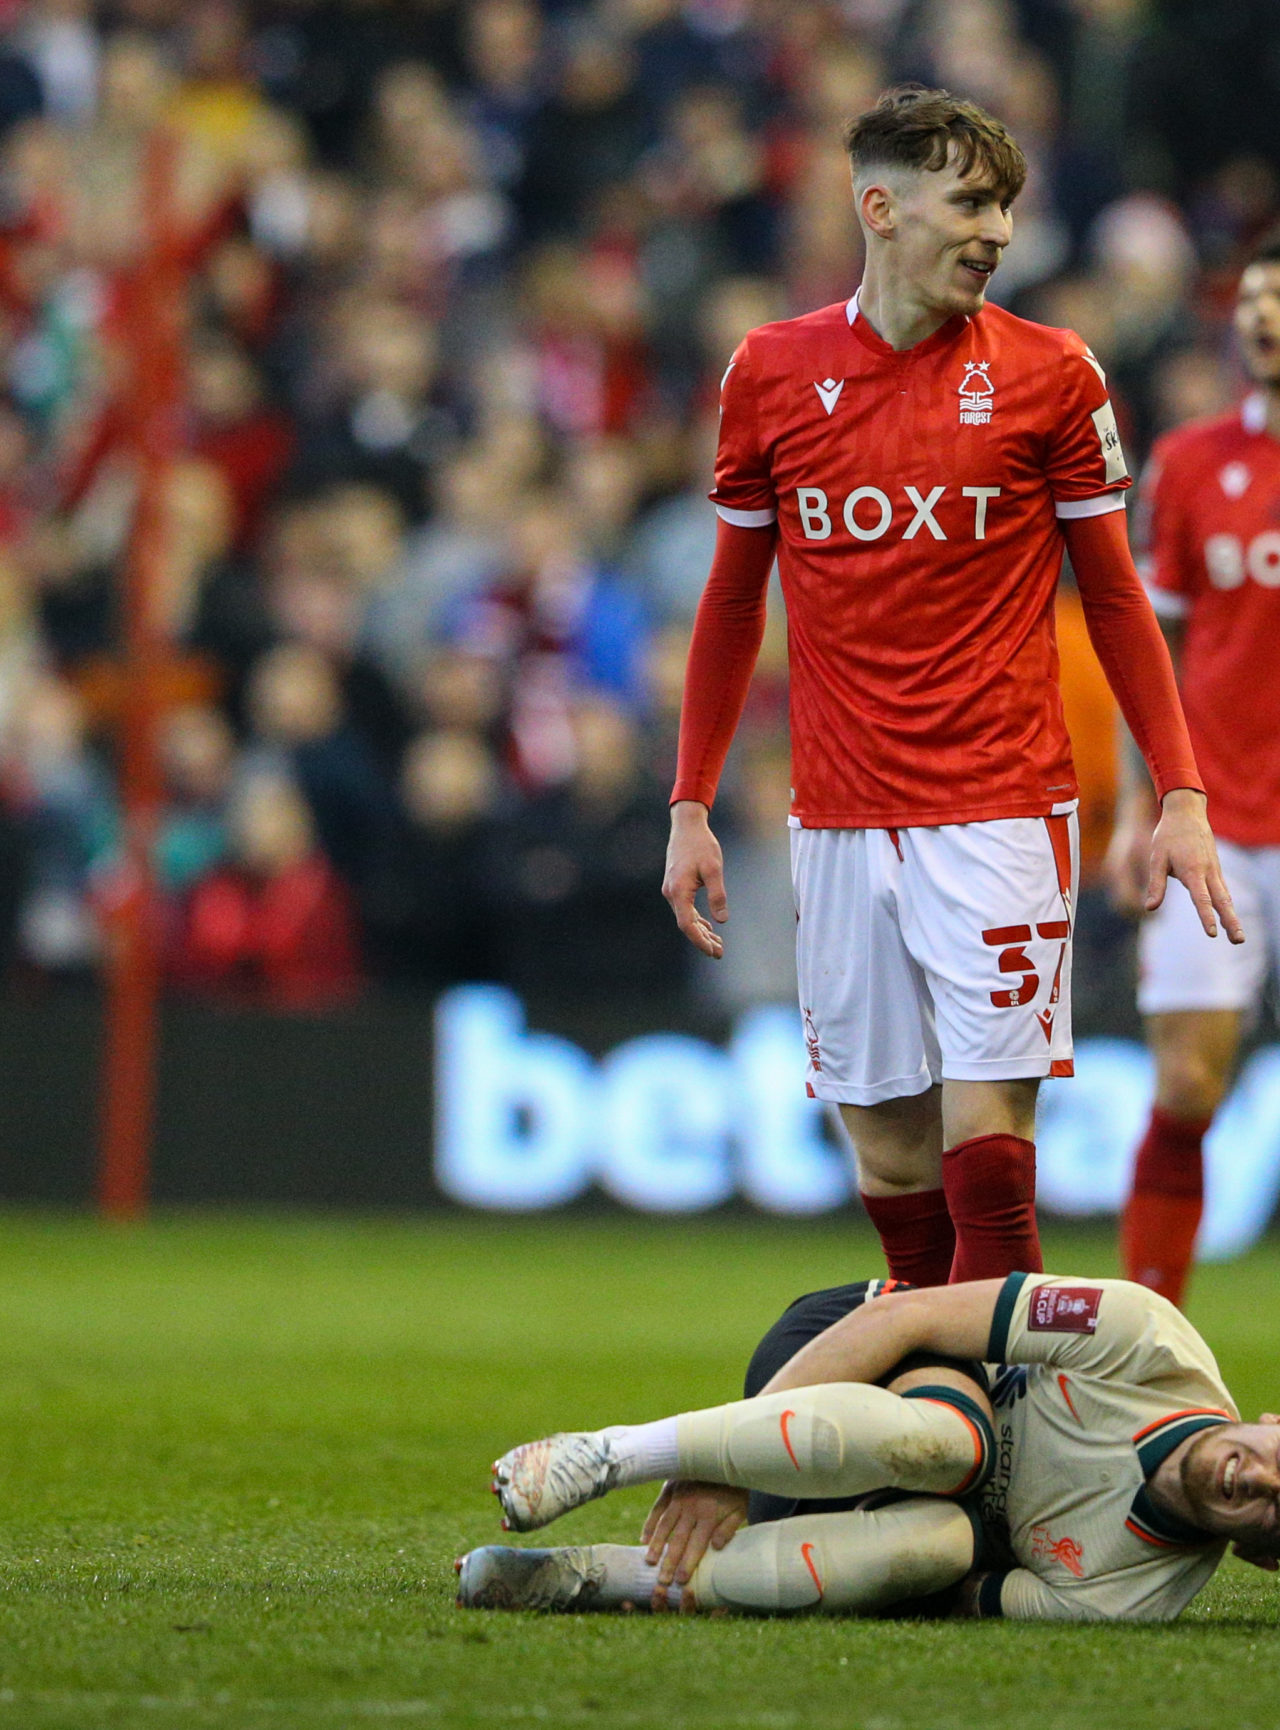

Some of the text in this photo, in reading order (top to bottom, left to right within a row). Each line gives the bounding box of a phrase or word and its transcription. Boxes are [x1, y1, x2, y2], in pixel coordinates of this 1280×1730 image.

[959, 411, 992, 426] FOREST
[796, 486, 1001, 541] BOXT
[981, 920, 1069, 1008] 37
[1036, 1300, 1048, 1325] CUP
[997, 1422, 1014, 1516] stand
